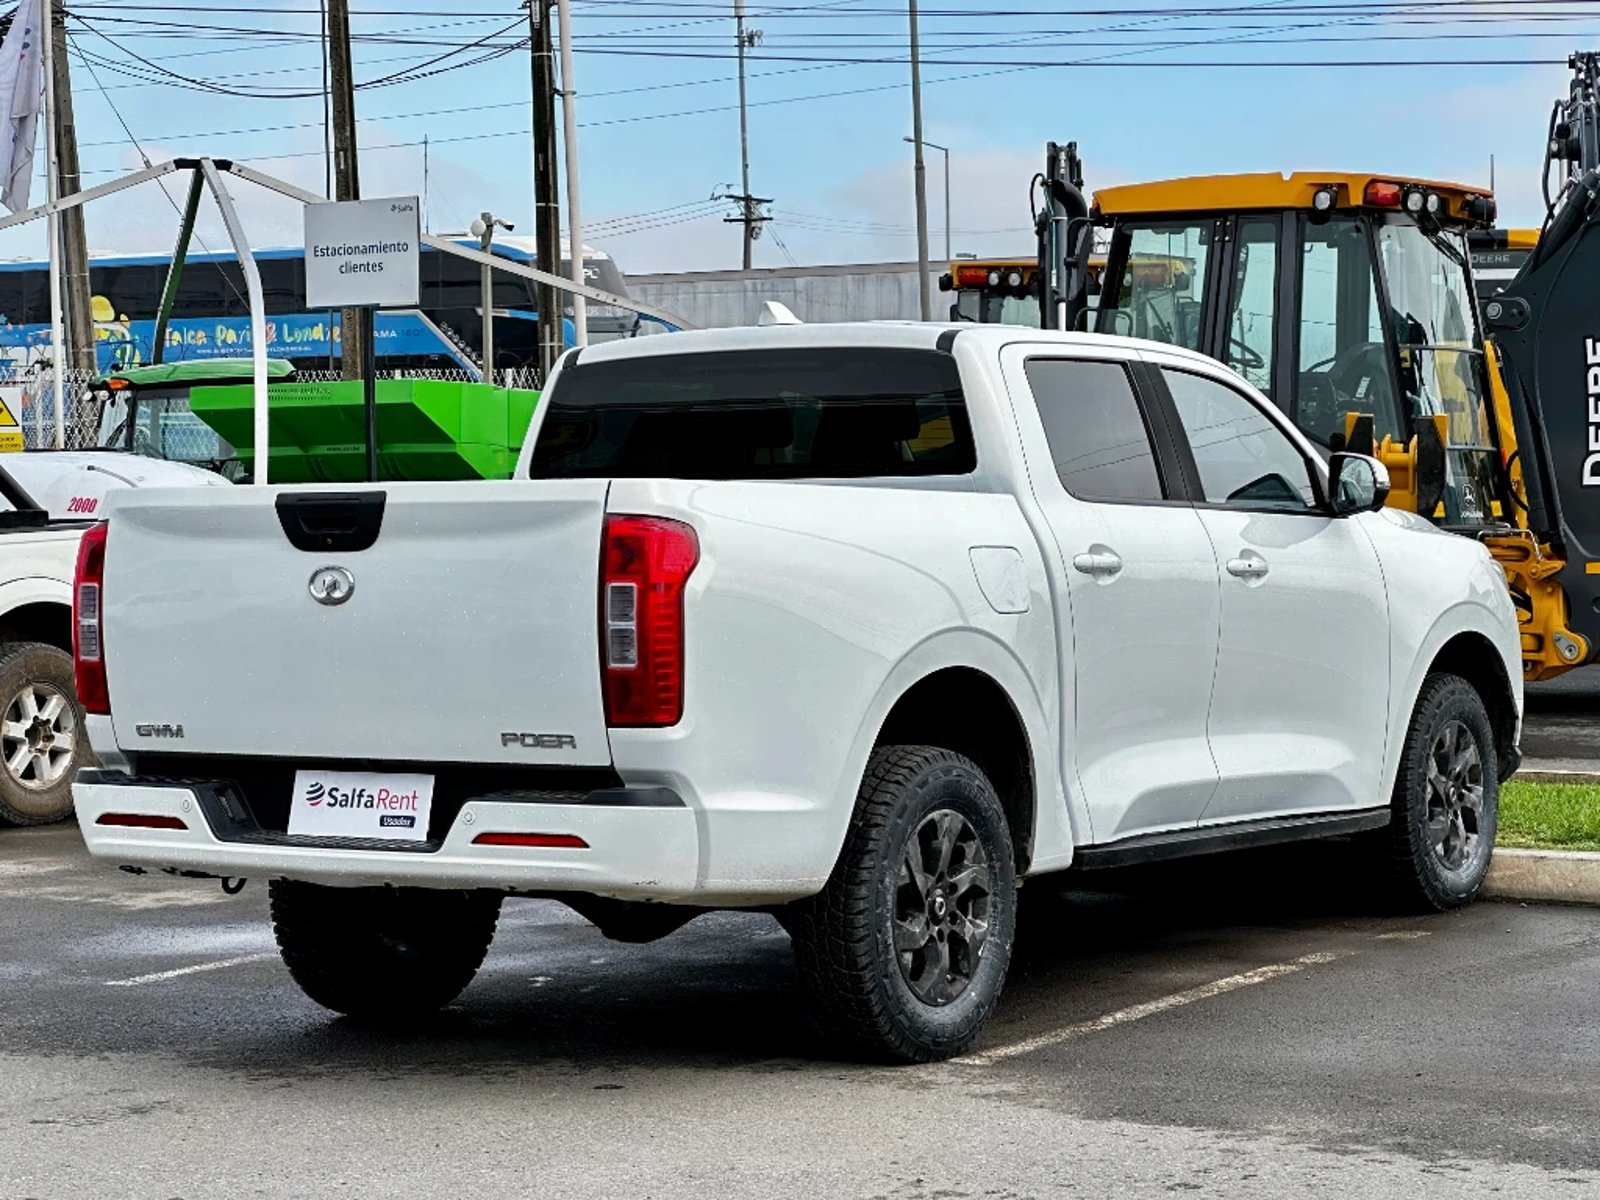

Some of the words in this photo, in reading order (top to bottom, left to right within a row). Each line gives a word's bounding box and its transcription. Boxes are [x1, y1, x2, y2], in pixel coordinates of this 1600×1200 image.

[313, 240, 409, 258] Estacionamiento
[1471, 254, 1510, 264] DEERE
[339, 261, 384, 275] clientes
[215, 324, 252, 347] Pari
[282, 322, 341, 343] Londre
[67, 496, 98, 513] 2000
[135, 724, 185, 738] GWM
[500, 732, 577, 750] POER
[326, 787, 418, 811] SalfaRent
